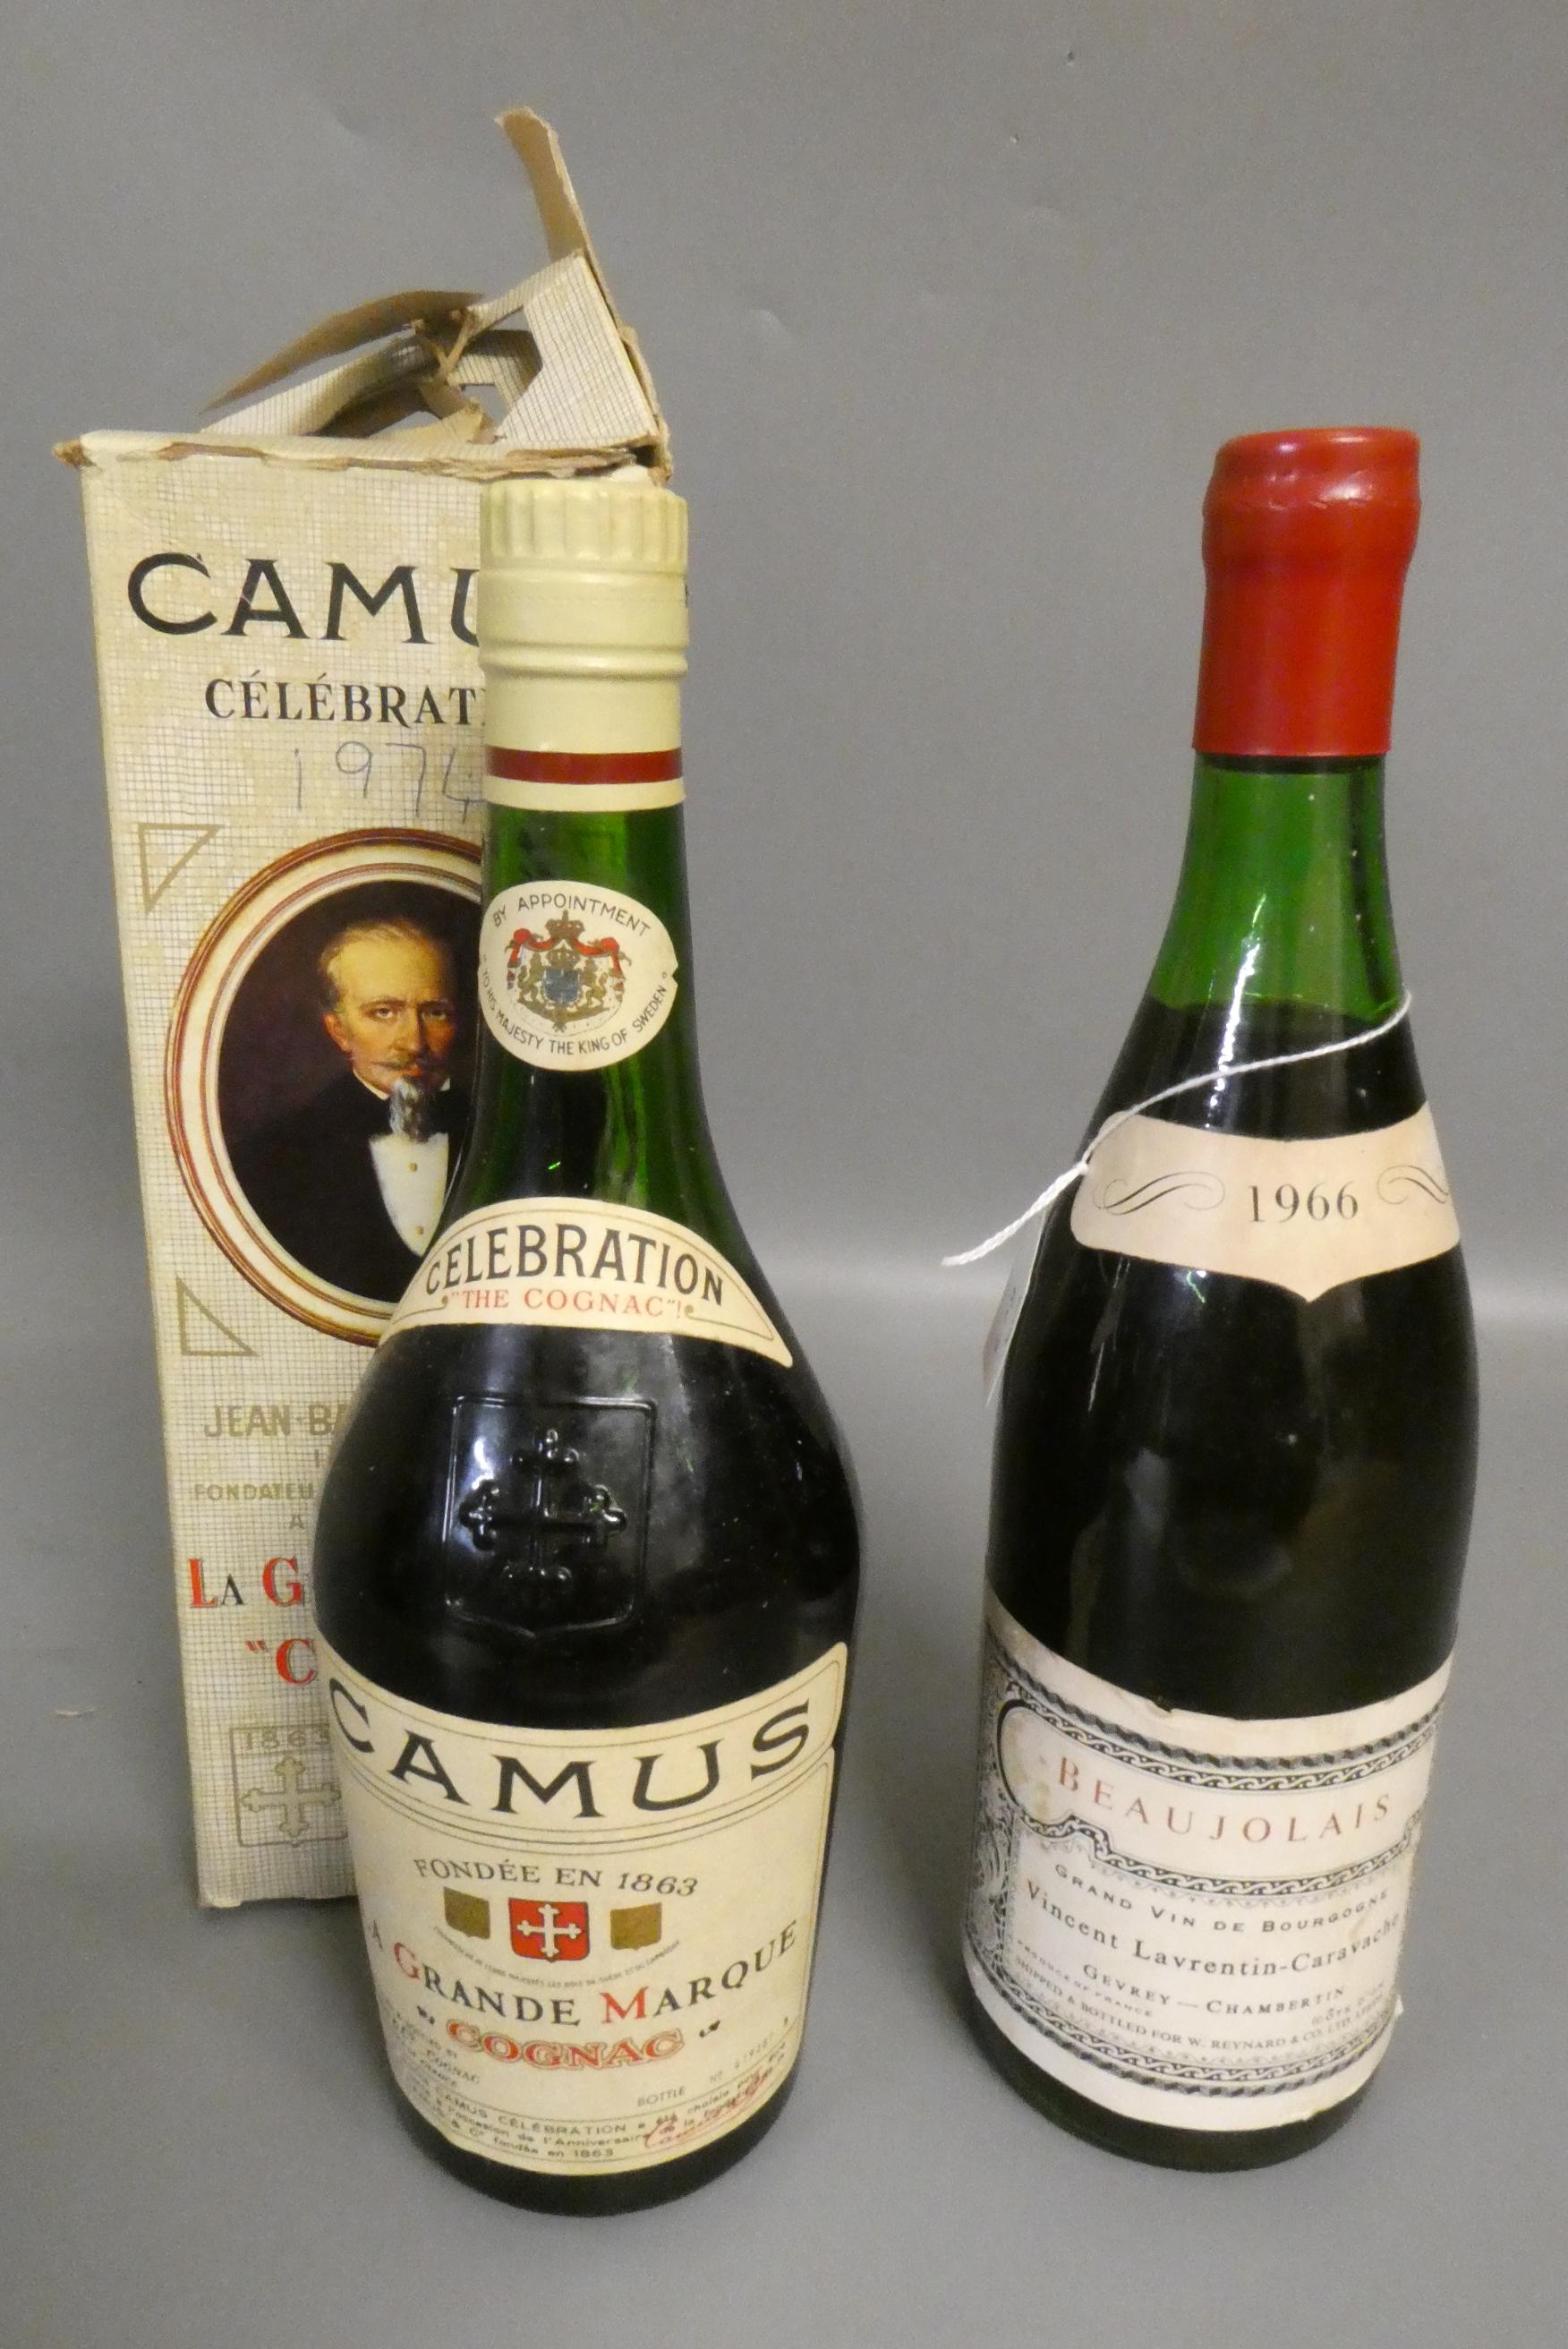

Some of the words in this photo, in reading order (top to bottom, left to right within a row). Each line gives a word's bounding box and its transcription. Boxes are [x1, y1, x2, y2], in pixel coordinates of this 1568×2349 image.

[204, 670, 484, 730] CÉLÉBRAT
[493, 904, 507, 928] BY
[517, 893, 652, 936] APPOINTMENT
[495, 1009, 545, 1050] MAJESTY
[549, 1038, 575, 1055] THE
[578, 1036, 610, 1055] KING
[610, 1028, 628, 1047] OF
[632, 985, 668, 1033] SWEDEN
[1248, 1180, 1360, 1224] 1966
[425, 1222, 724, 1308] CELEBRATION
[194, 1482, 314, 1501] FONDATEU
[188, 1557, 244, 1609] LA
[328, 1677, 810, 1819] CAMUS
[1058, 1755, 1391, 1844] BEAUJOLAIS
[413, 1858, 541, 1884] FONDÉE
[555, 1866, 601, 1887] EN
[617, 1871, 699, 1897] 1863
[1055, 1863, 1133, 1910] GRAND
[1150, 1904, 1197, 1927] VIN
[1213, 1920, 1245, 1933] DE
[1262, 1888, 1389, 1934] BOURGOGNE
[1027, 1879, 1120, 1950] Vincent
[393, 1942, 581, 2027] GRANDE
[600, 1919, 797, 2024] MARQUE
[446, 2018, 686, 2071] COGNAC
[1081, 2002, 1147, 2035] BOTTLED
[1152, 2029, 1183, 2044] FOR
[1211, 2033, 1287, 2050] REYNARD
